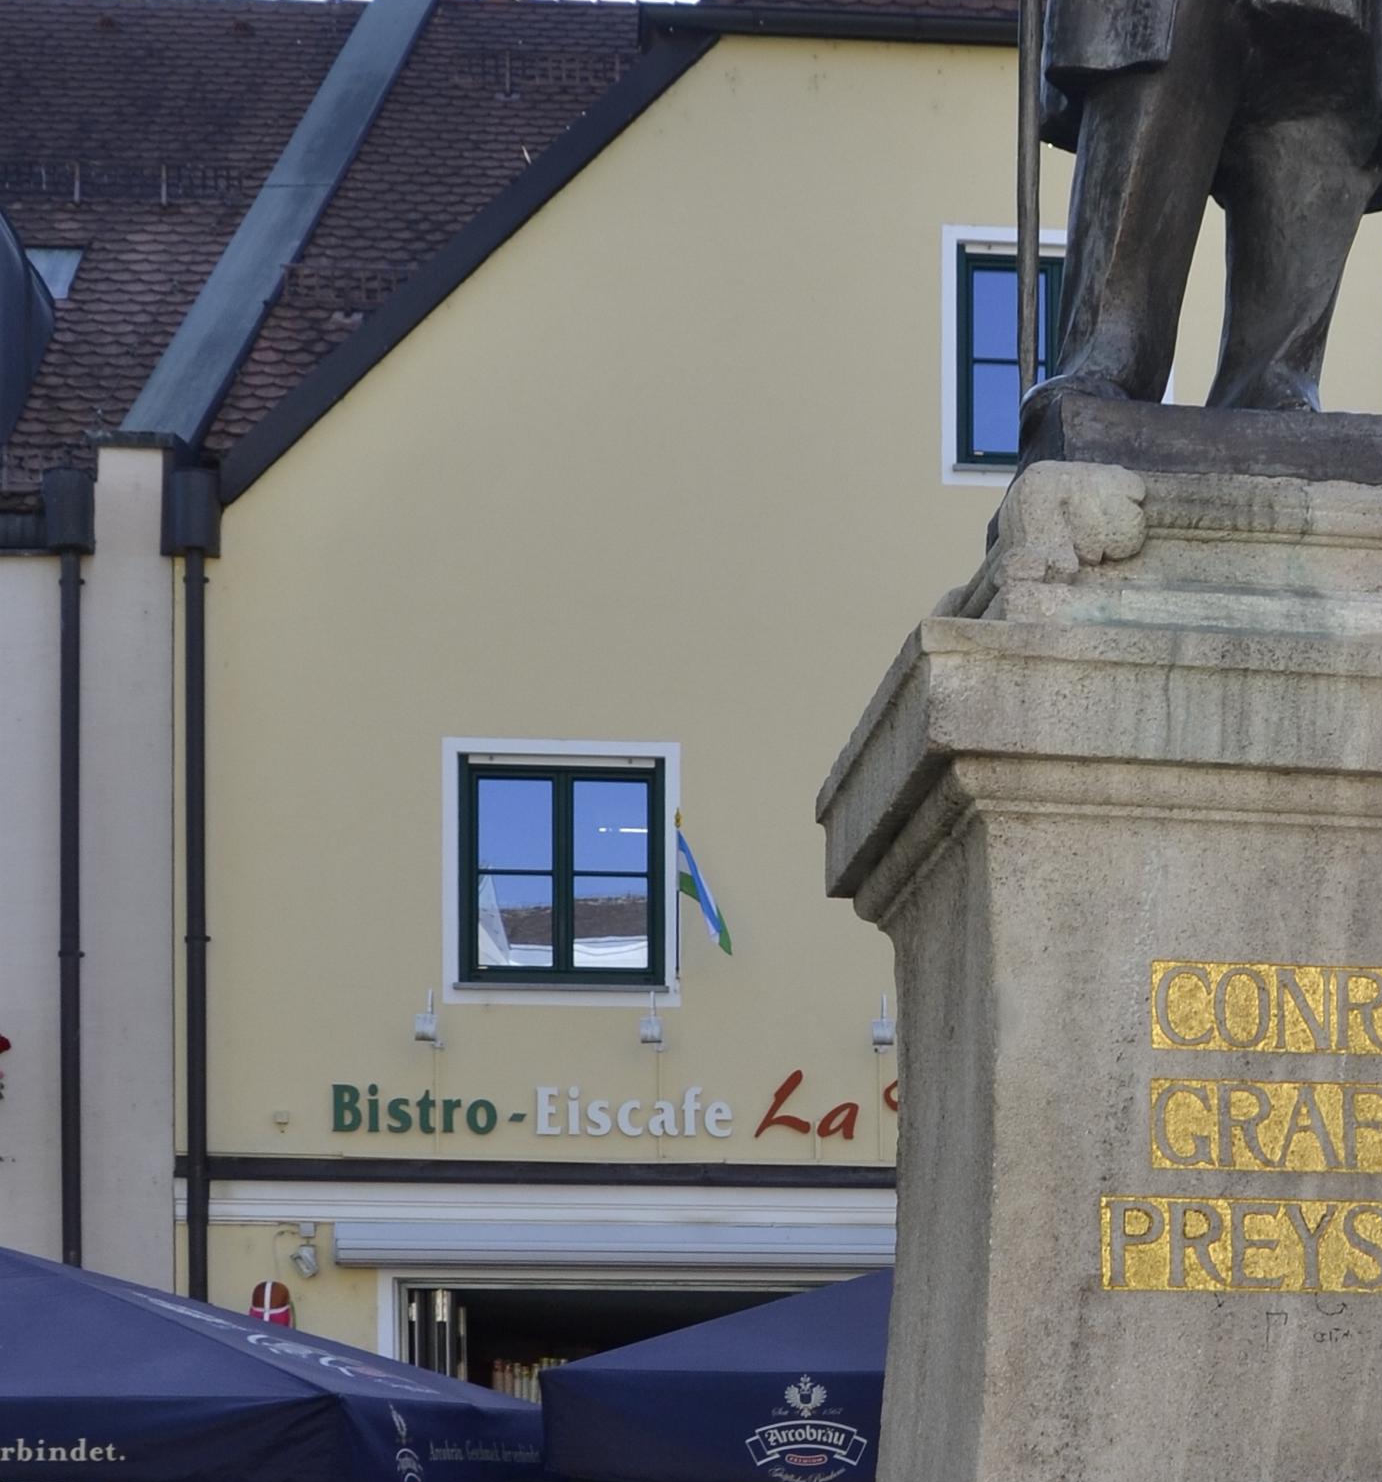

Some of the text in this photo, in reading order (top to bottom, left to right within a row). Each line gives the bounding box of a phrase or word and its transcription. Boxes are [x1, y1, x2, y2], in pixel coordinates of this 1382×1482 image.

[754, 1069, 860, 1140] La
[764, 1424, 846, 1446] Arcobräu
[0, 1438, 126, 1462] rbindet.
